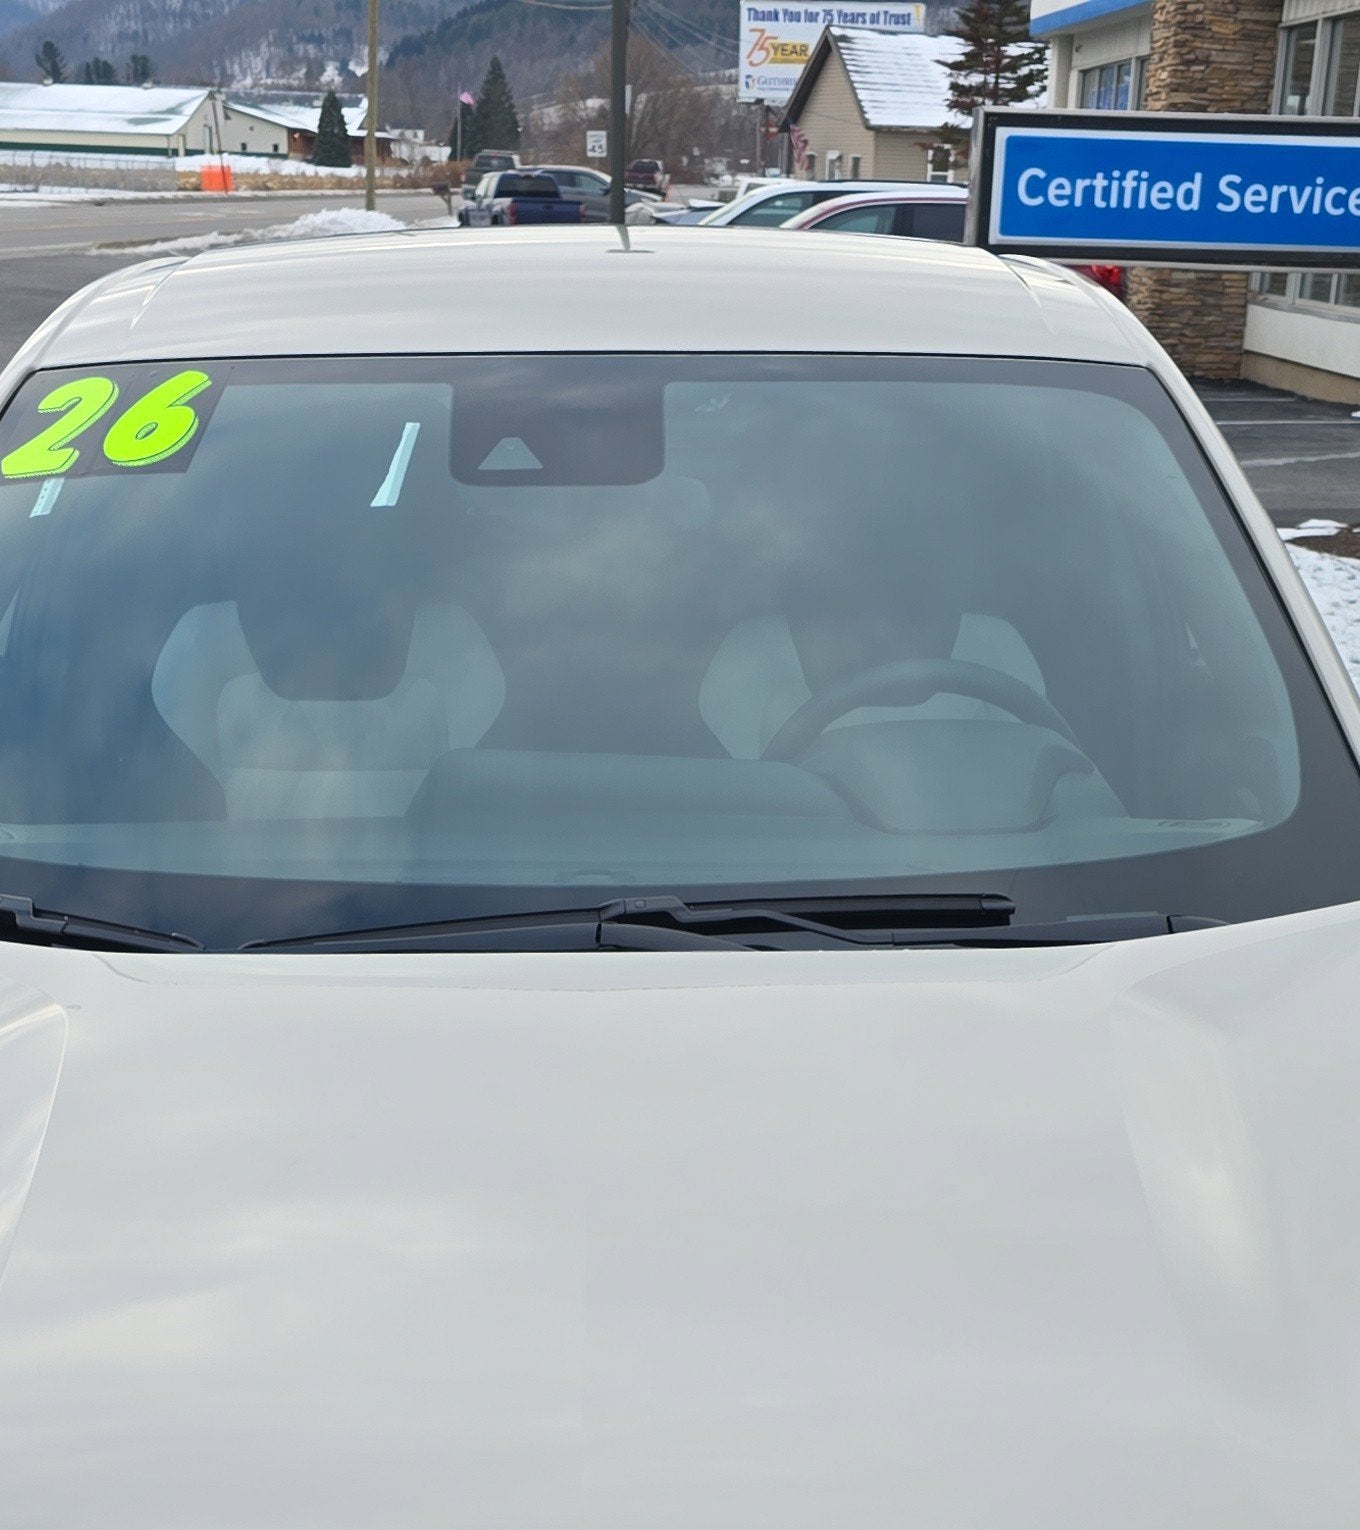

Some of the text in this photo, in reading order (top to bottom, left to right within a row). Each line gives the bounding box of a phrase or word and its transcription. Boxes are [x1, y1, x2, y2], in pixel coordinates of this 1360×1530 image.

[746, 7, 779, 23] Thank
[782, 8, 802, 24] You
[804, 9, 820, 24] for
[836, 10, 867, 25] Years
[869, 10, 881, 25] of
[746, 28, 810, 67] 75 YEAR
[1017, 167, 1203, 211] Certified
[0, 369, 213, 479] 26
